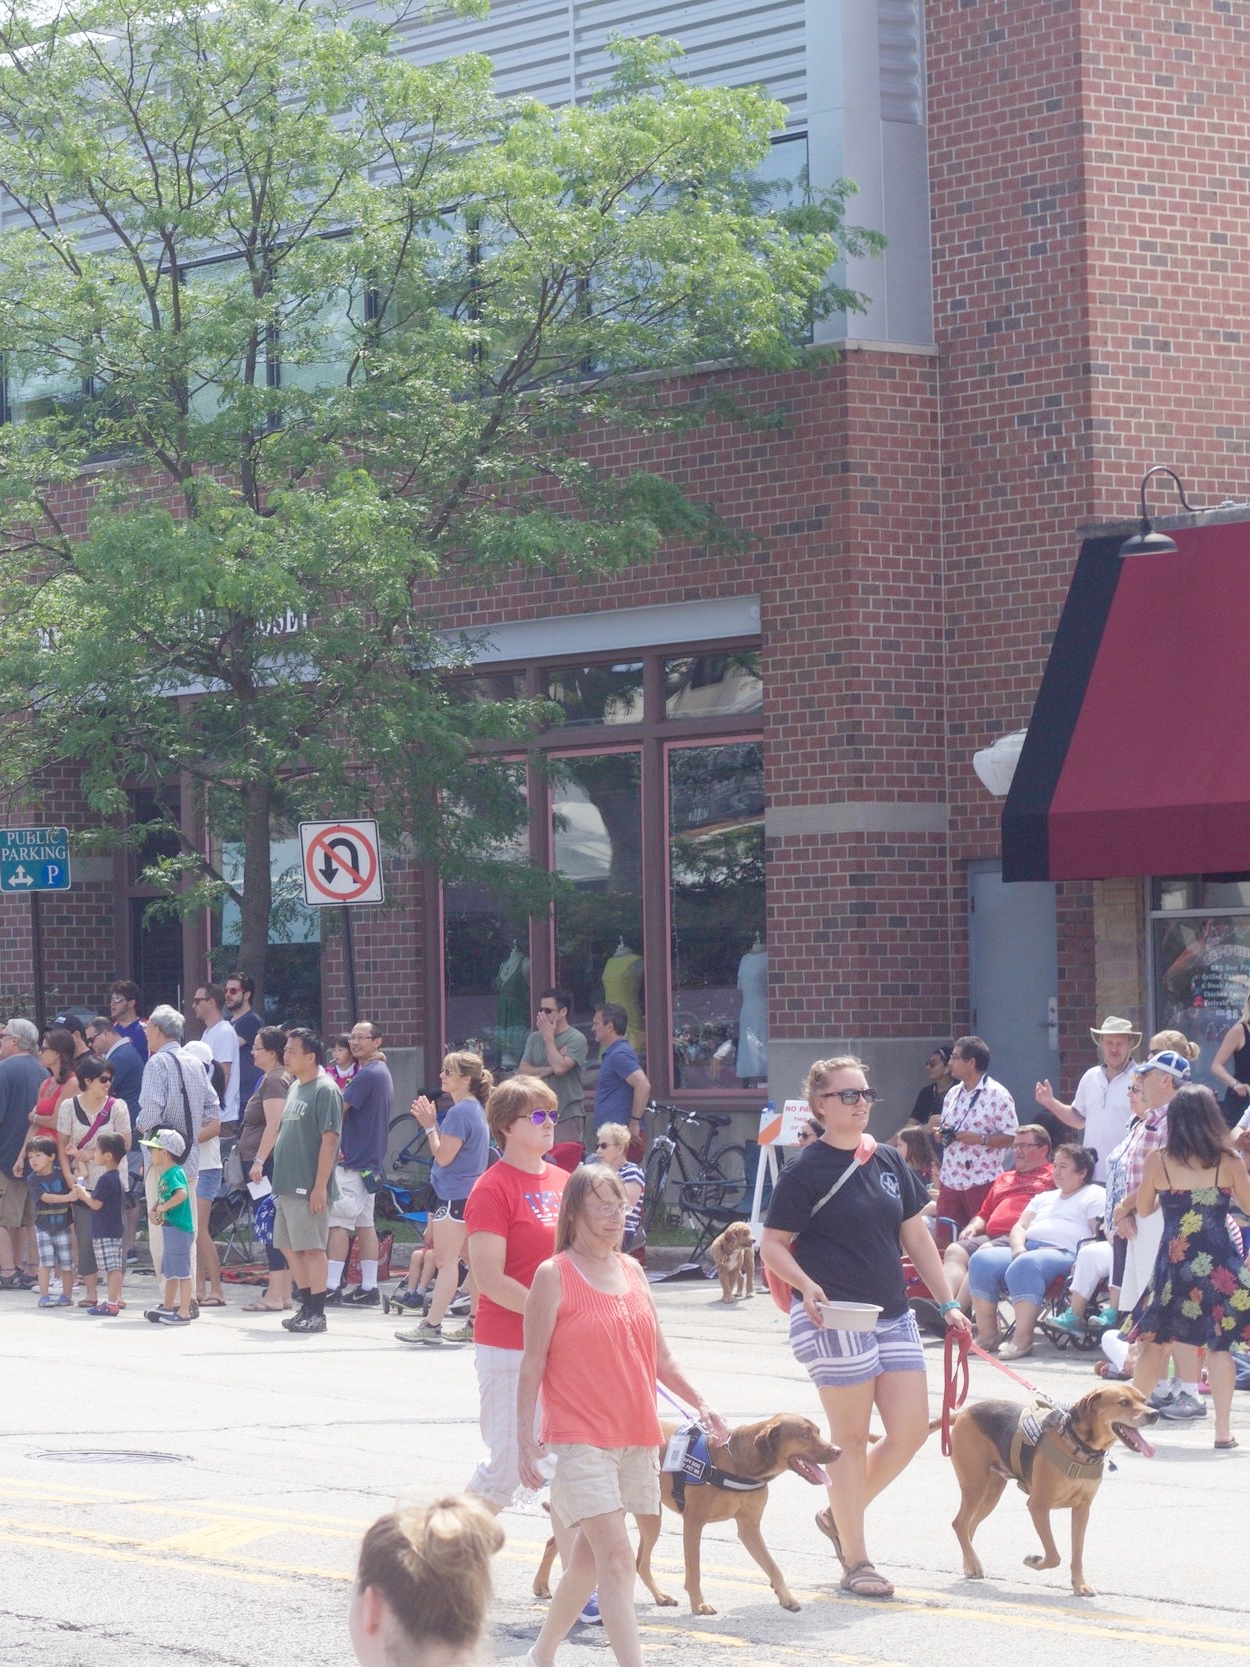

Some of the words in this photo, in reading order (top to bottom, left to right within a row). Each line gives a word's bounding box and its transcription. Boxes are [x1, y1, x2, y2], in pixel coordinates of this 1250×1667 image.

[6, 830, 60, 845] PUBLIC
[1, 846, 66, 861] PARKING
[46, 865, 59, 884] P
